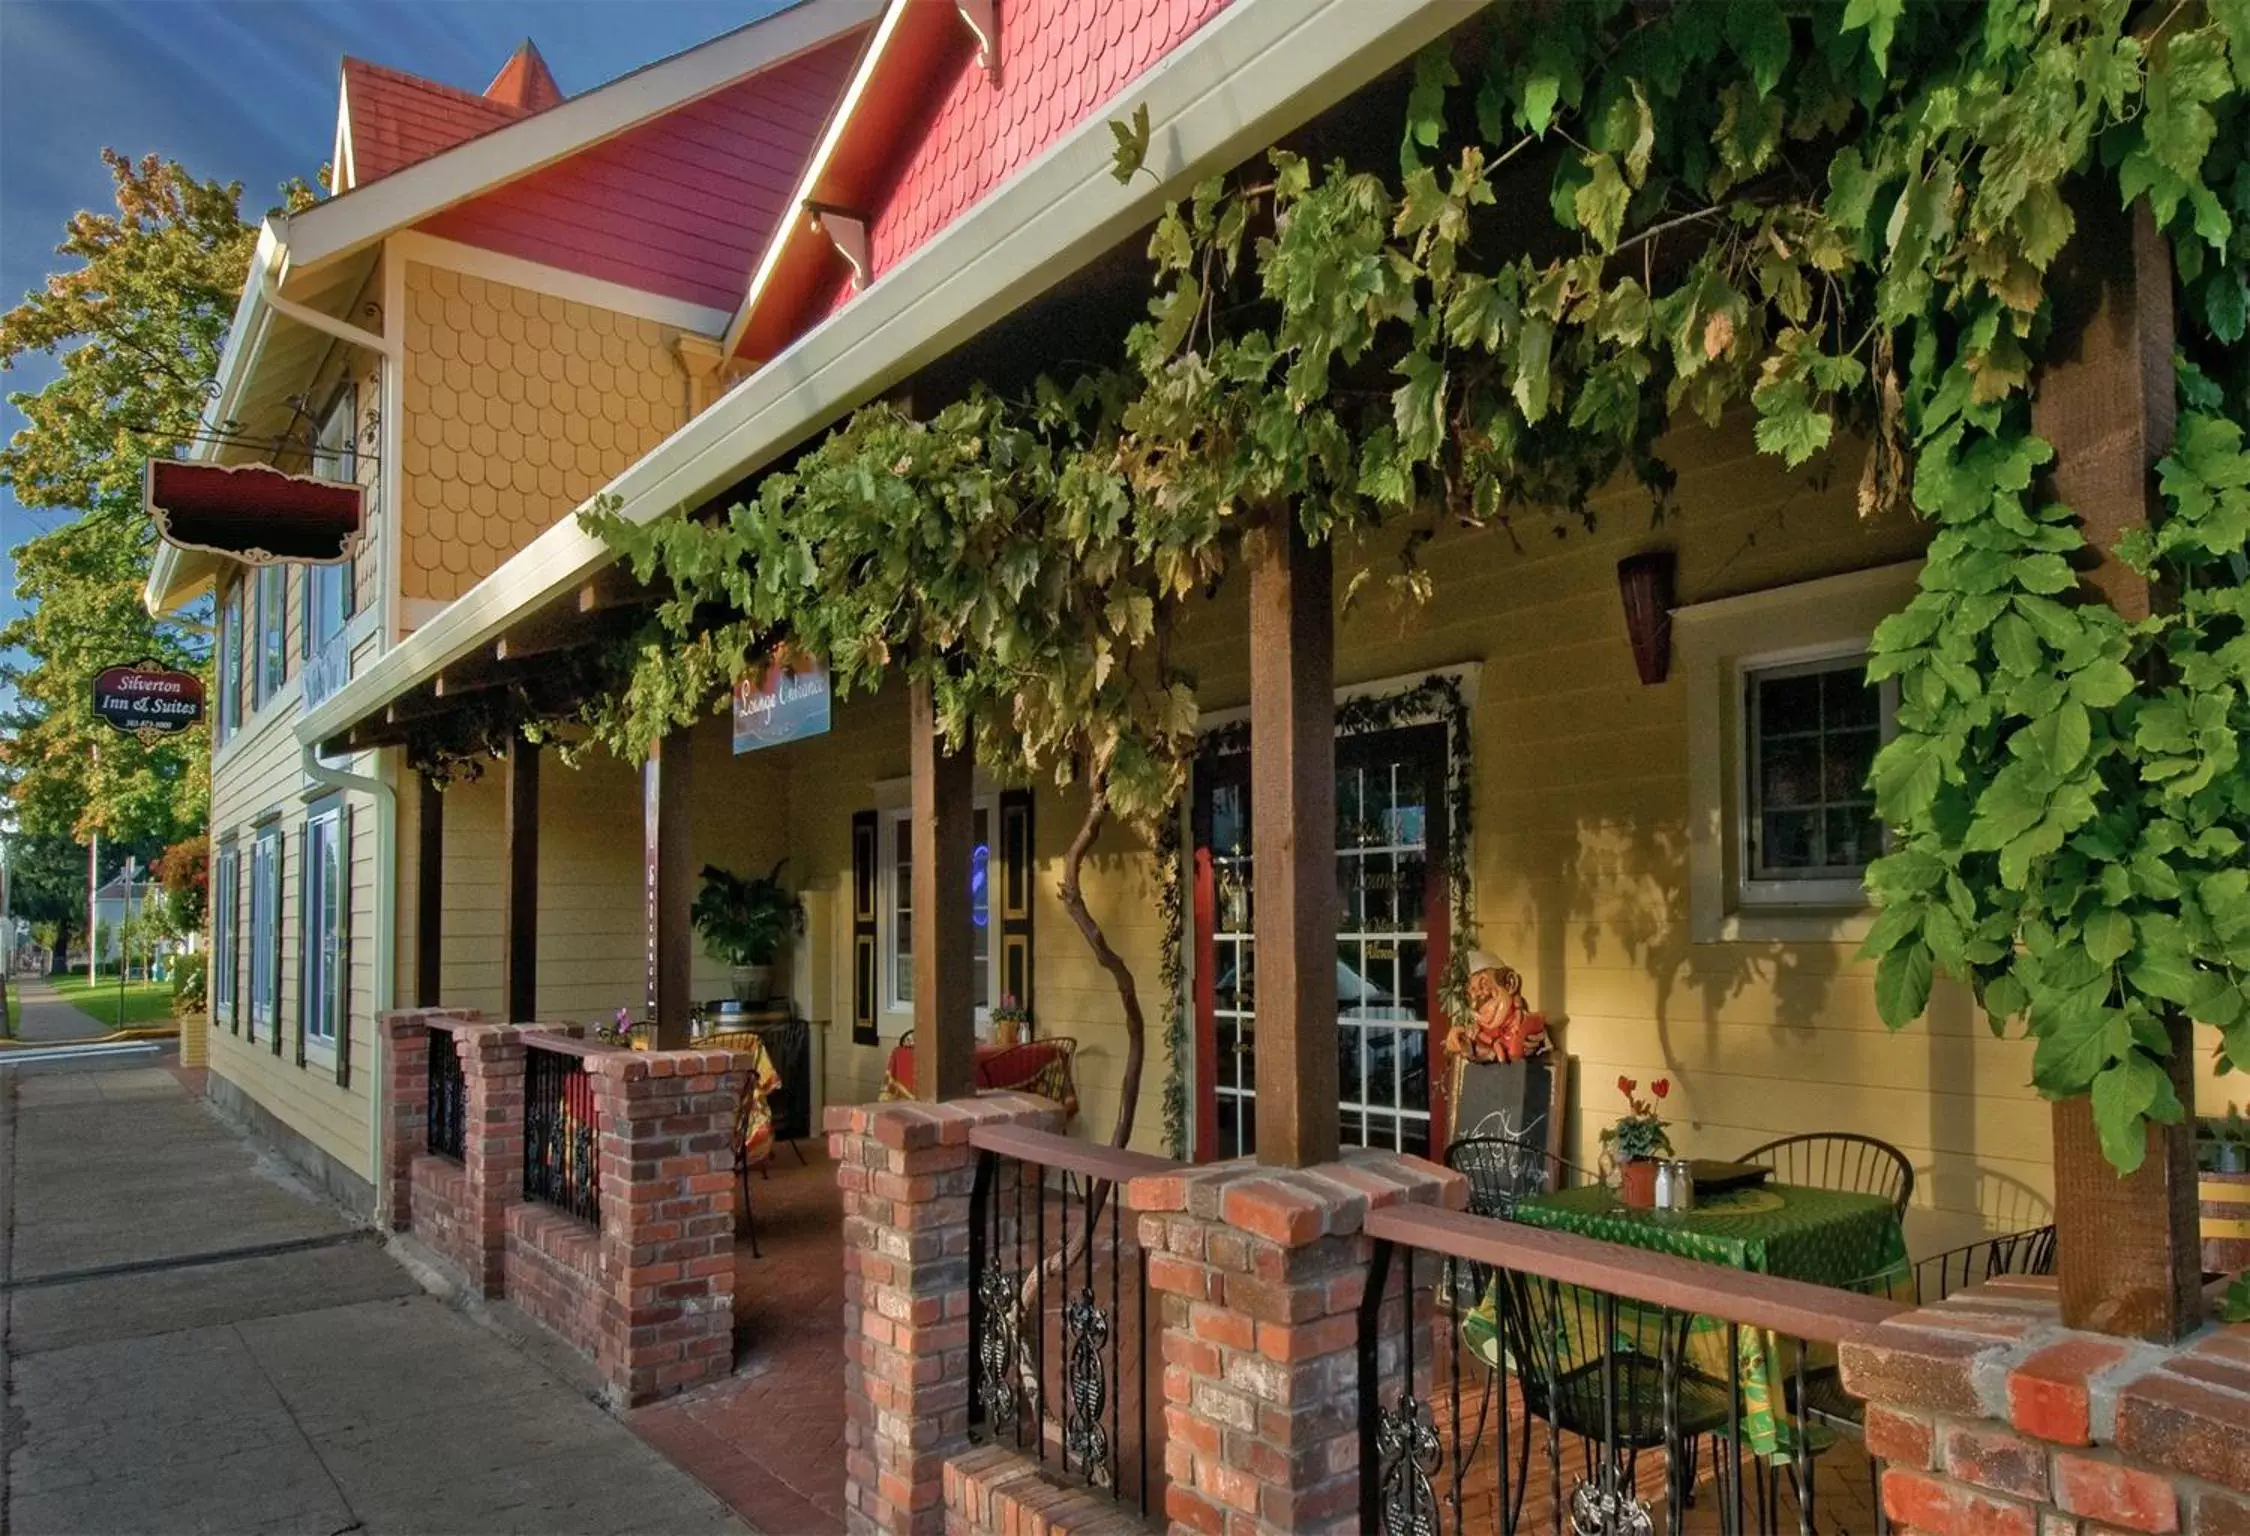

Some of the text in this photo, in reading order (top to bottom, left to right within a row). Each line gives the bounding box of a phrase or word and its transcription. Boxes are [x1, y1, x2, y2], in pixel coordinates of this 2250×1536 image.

[118, 675, 181, 692] Silverton
[102, 695, 196, 714] Inn & Suites
[739, 679, 776, 725] Lounge
